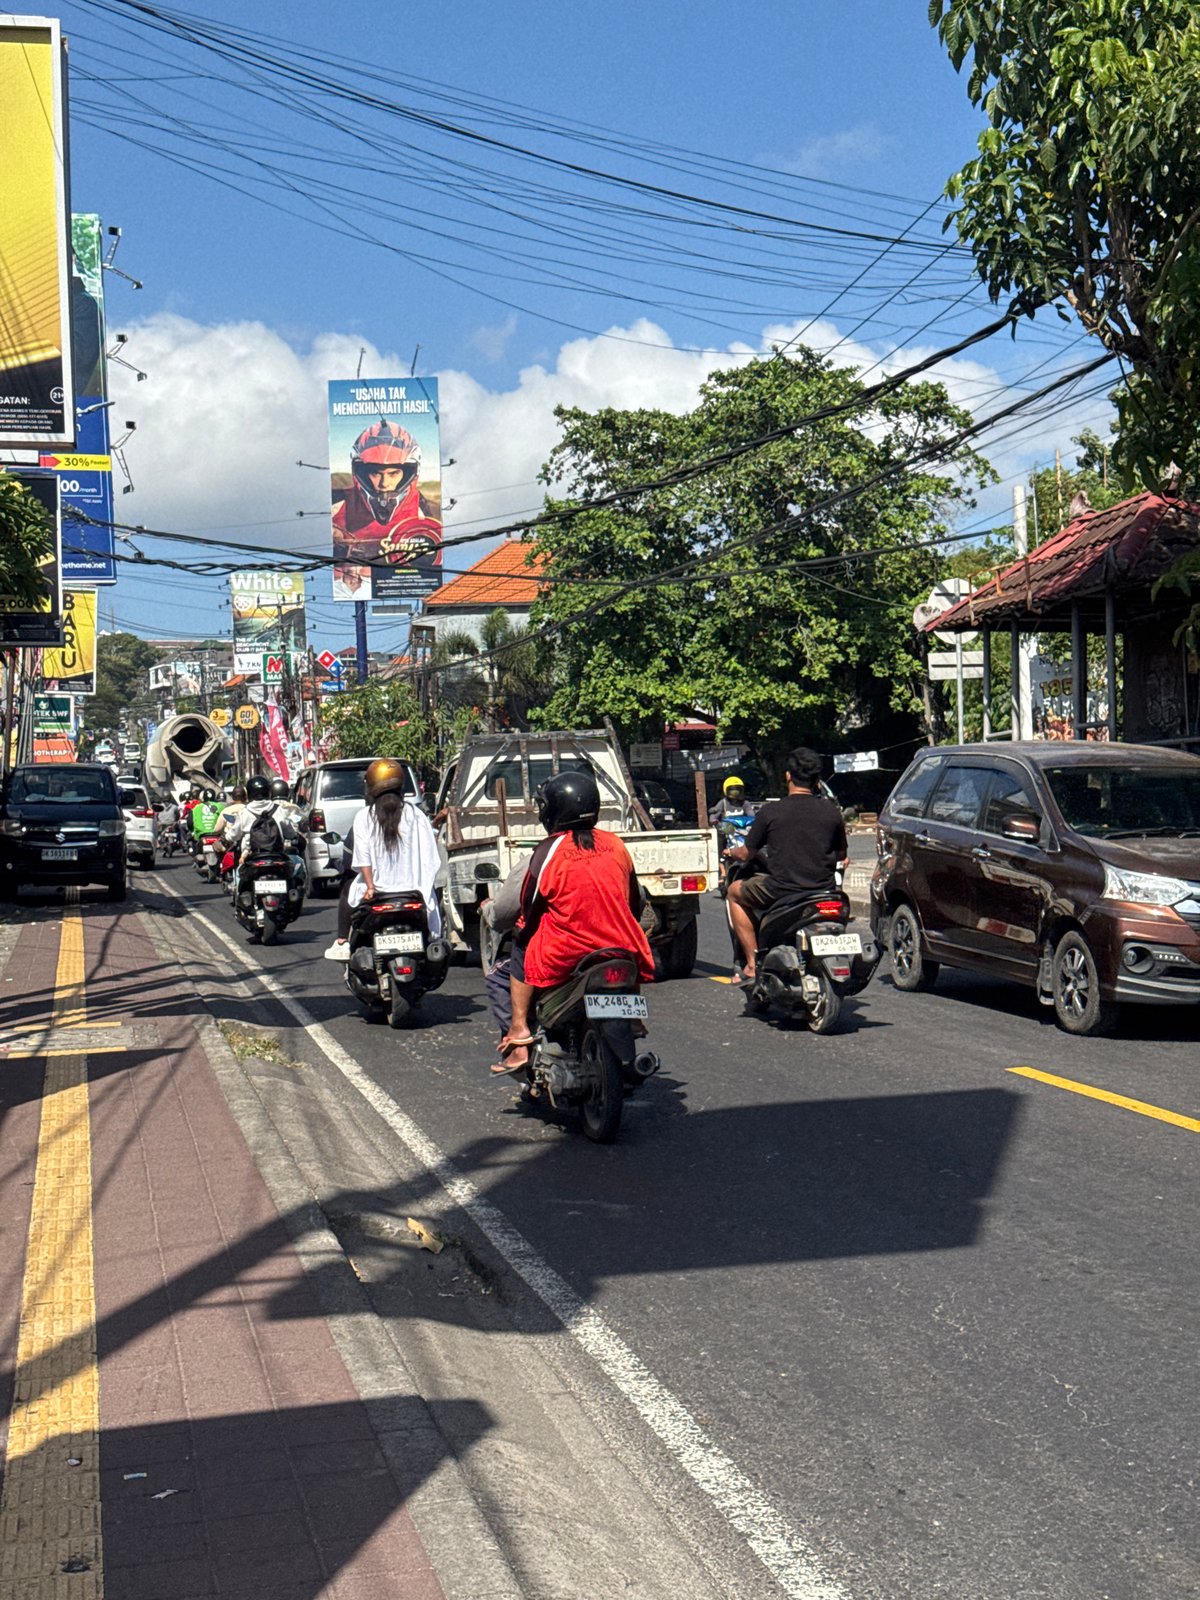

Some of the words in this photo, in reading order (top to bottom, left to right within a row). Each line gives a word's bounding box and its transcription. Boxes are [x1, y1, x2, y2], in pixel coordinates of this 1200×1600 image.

[389, 387, 406, 399] TAK
[333, 402, 400, 415] MENGKHIANATI
[64, 457, 90, 467] 30%
[231, 572, 293, 590] White
[587, 996, 600, 1007] DK
